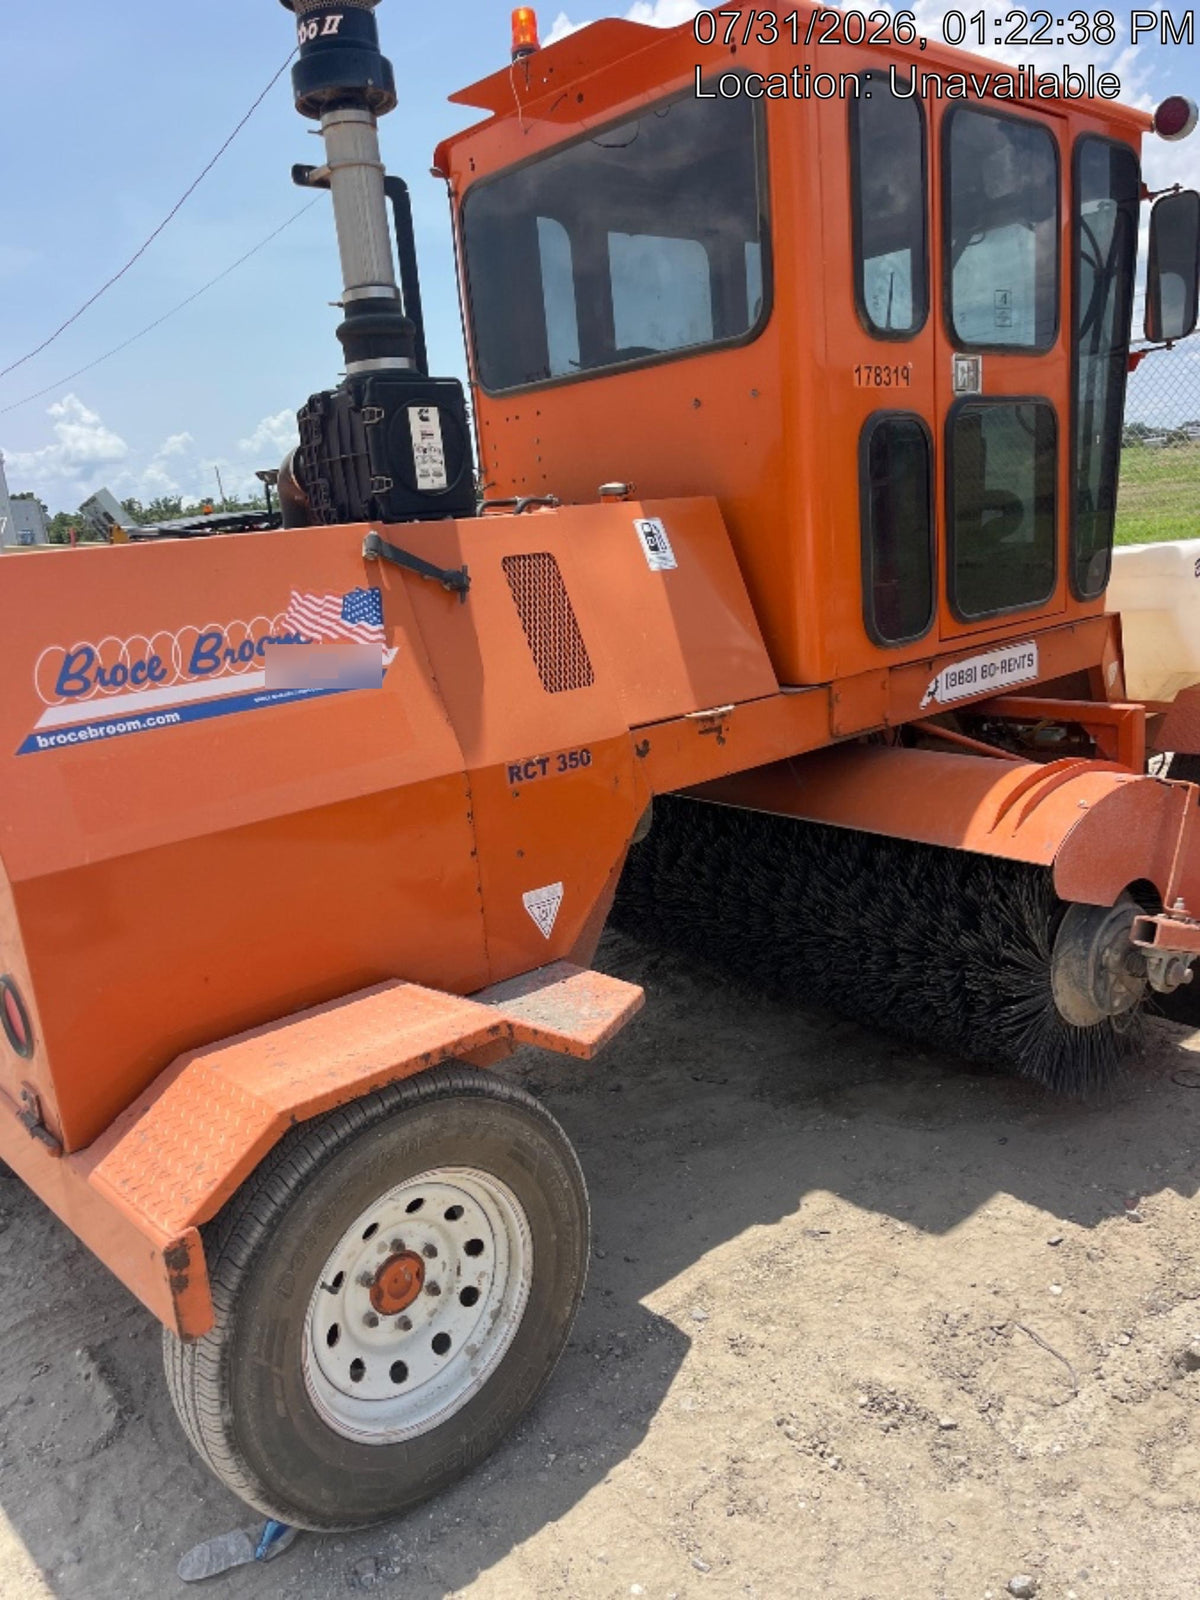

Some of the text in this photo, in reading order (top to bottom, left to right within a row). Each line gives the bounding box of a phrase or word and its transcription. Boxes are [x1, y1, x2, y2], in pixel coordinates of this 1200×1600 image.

[854, 364, 910, 387] 178319
[55, 646, 167, 697] Broce
[36, 710, 181, 749] brocebroom.com
[507, 747, 592, 785] RCT 350
